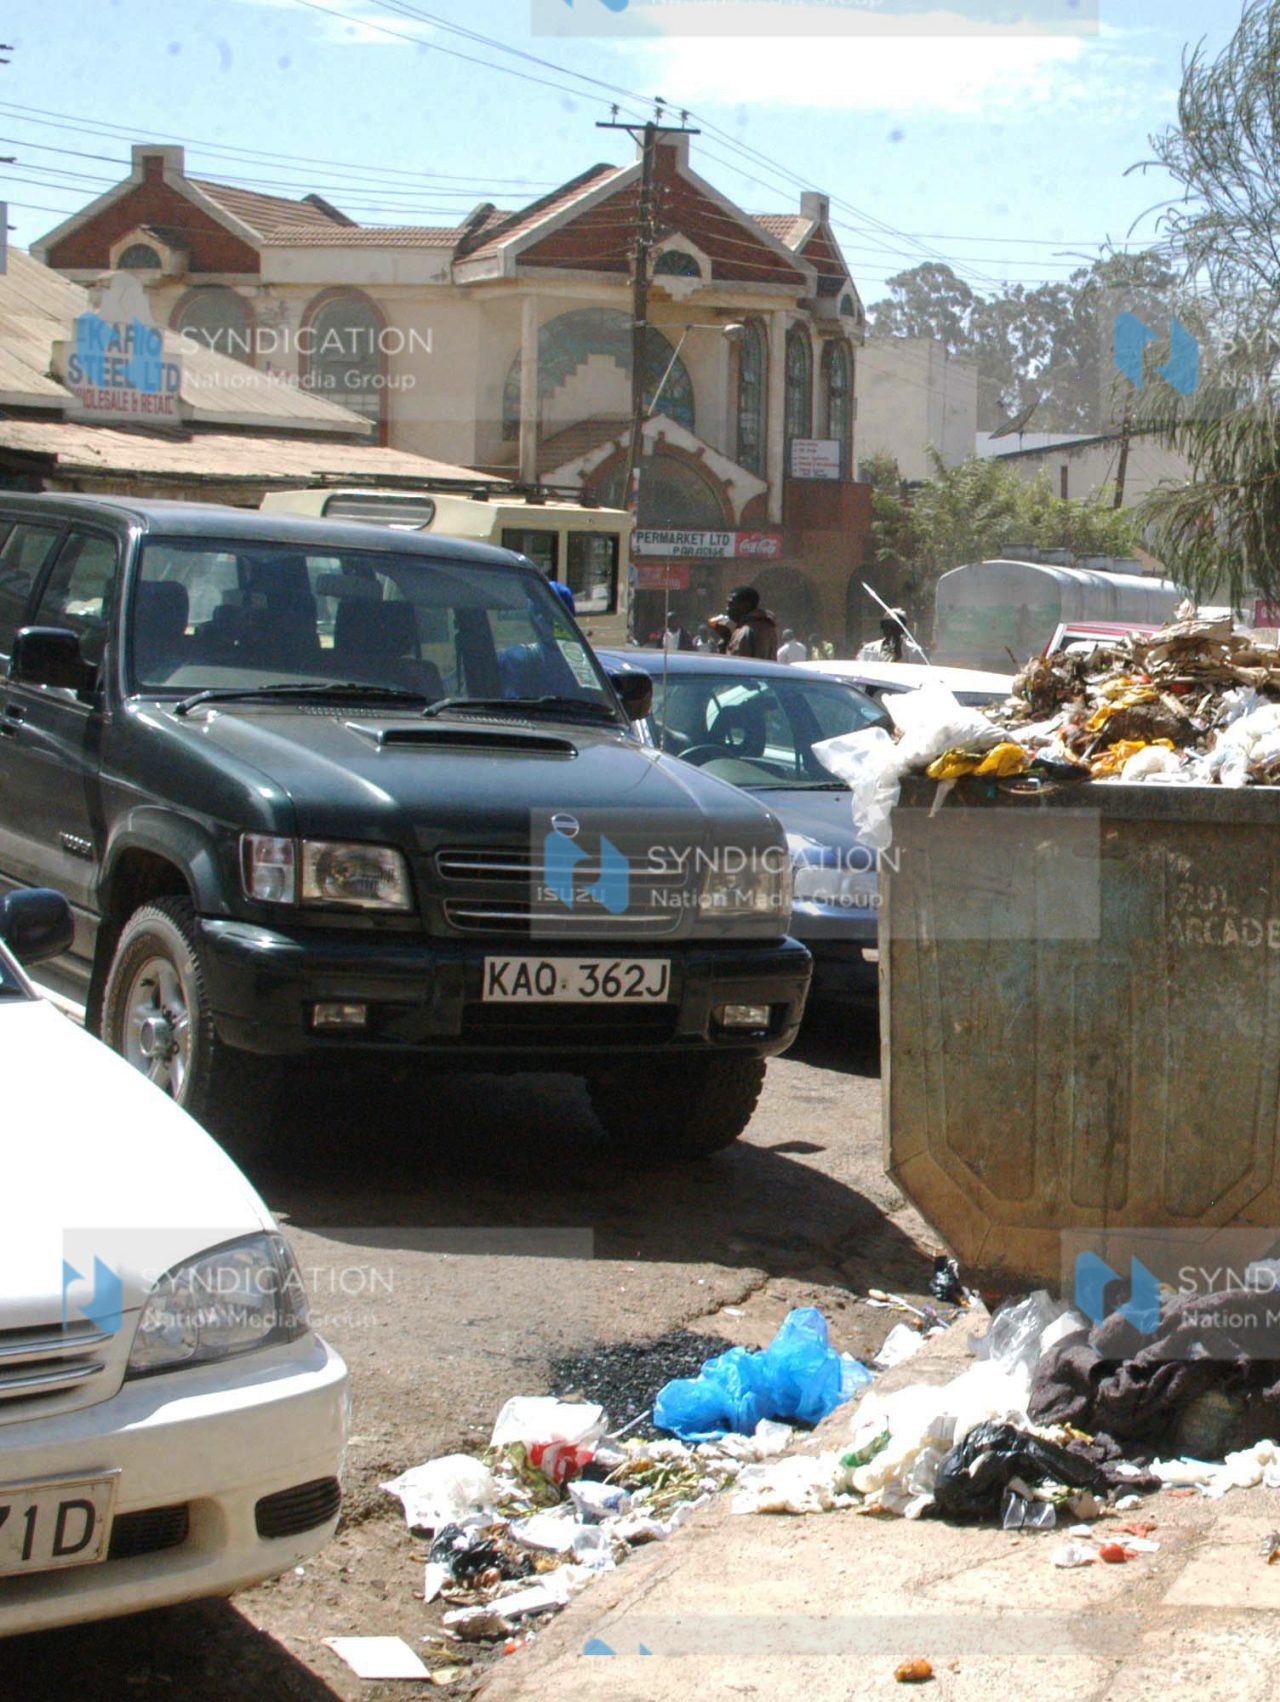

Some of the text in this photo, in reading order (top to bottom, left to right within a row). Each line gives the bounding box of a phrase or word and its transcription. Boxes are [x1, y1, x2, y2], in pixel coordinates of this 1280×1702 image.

[68, 353, 181, 393] STEEL LTD
[709, 533, 730, 546] LTD
[537, 886, 606, 903] ISUZU
[488, 961, 668, 997] KAQ 362J
